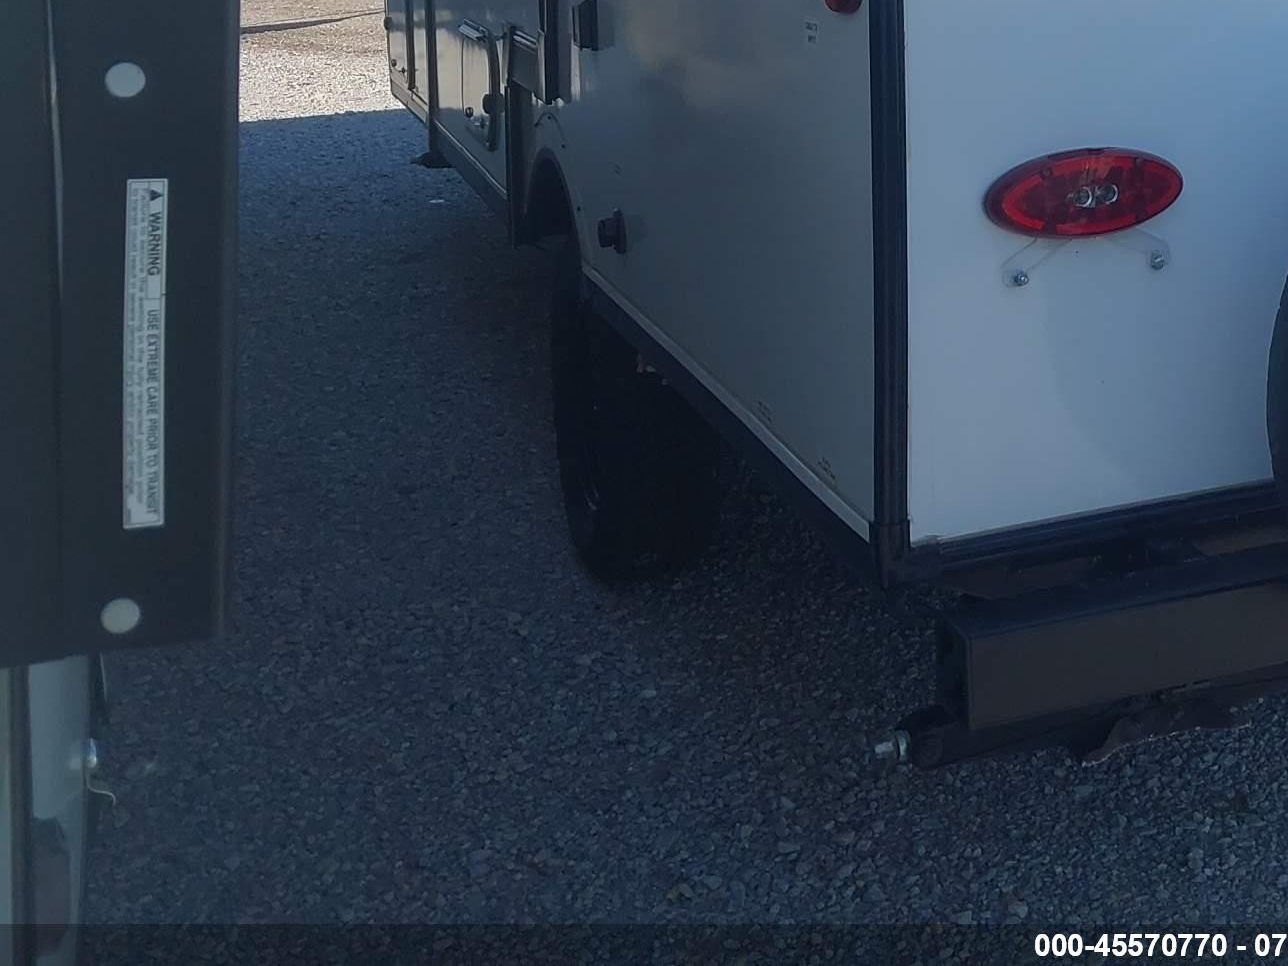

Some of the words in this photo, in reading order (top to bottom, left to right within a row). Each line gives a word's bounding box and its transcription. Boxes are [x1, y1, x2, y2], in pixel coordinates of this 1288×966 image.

[147, 211, 162, 277] WARNING
[146, 309, 161, 331] USE
[146, 333, 160, 383] EXTREME
[146, 386, 159, 416] CARE
[146, 418, 159, 451] PRIOR
[146, 454, 159, 468] TO
